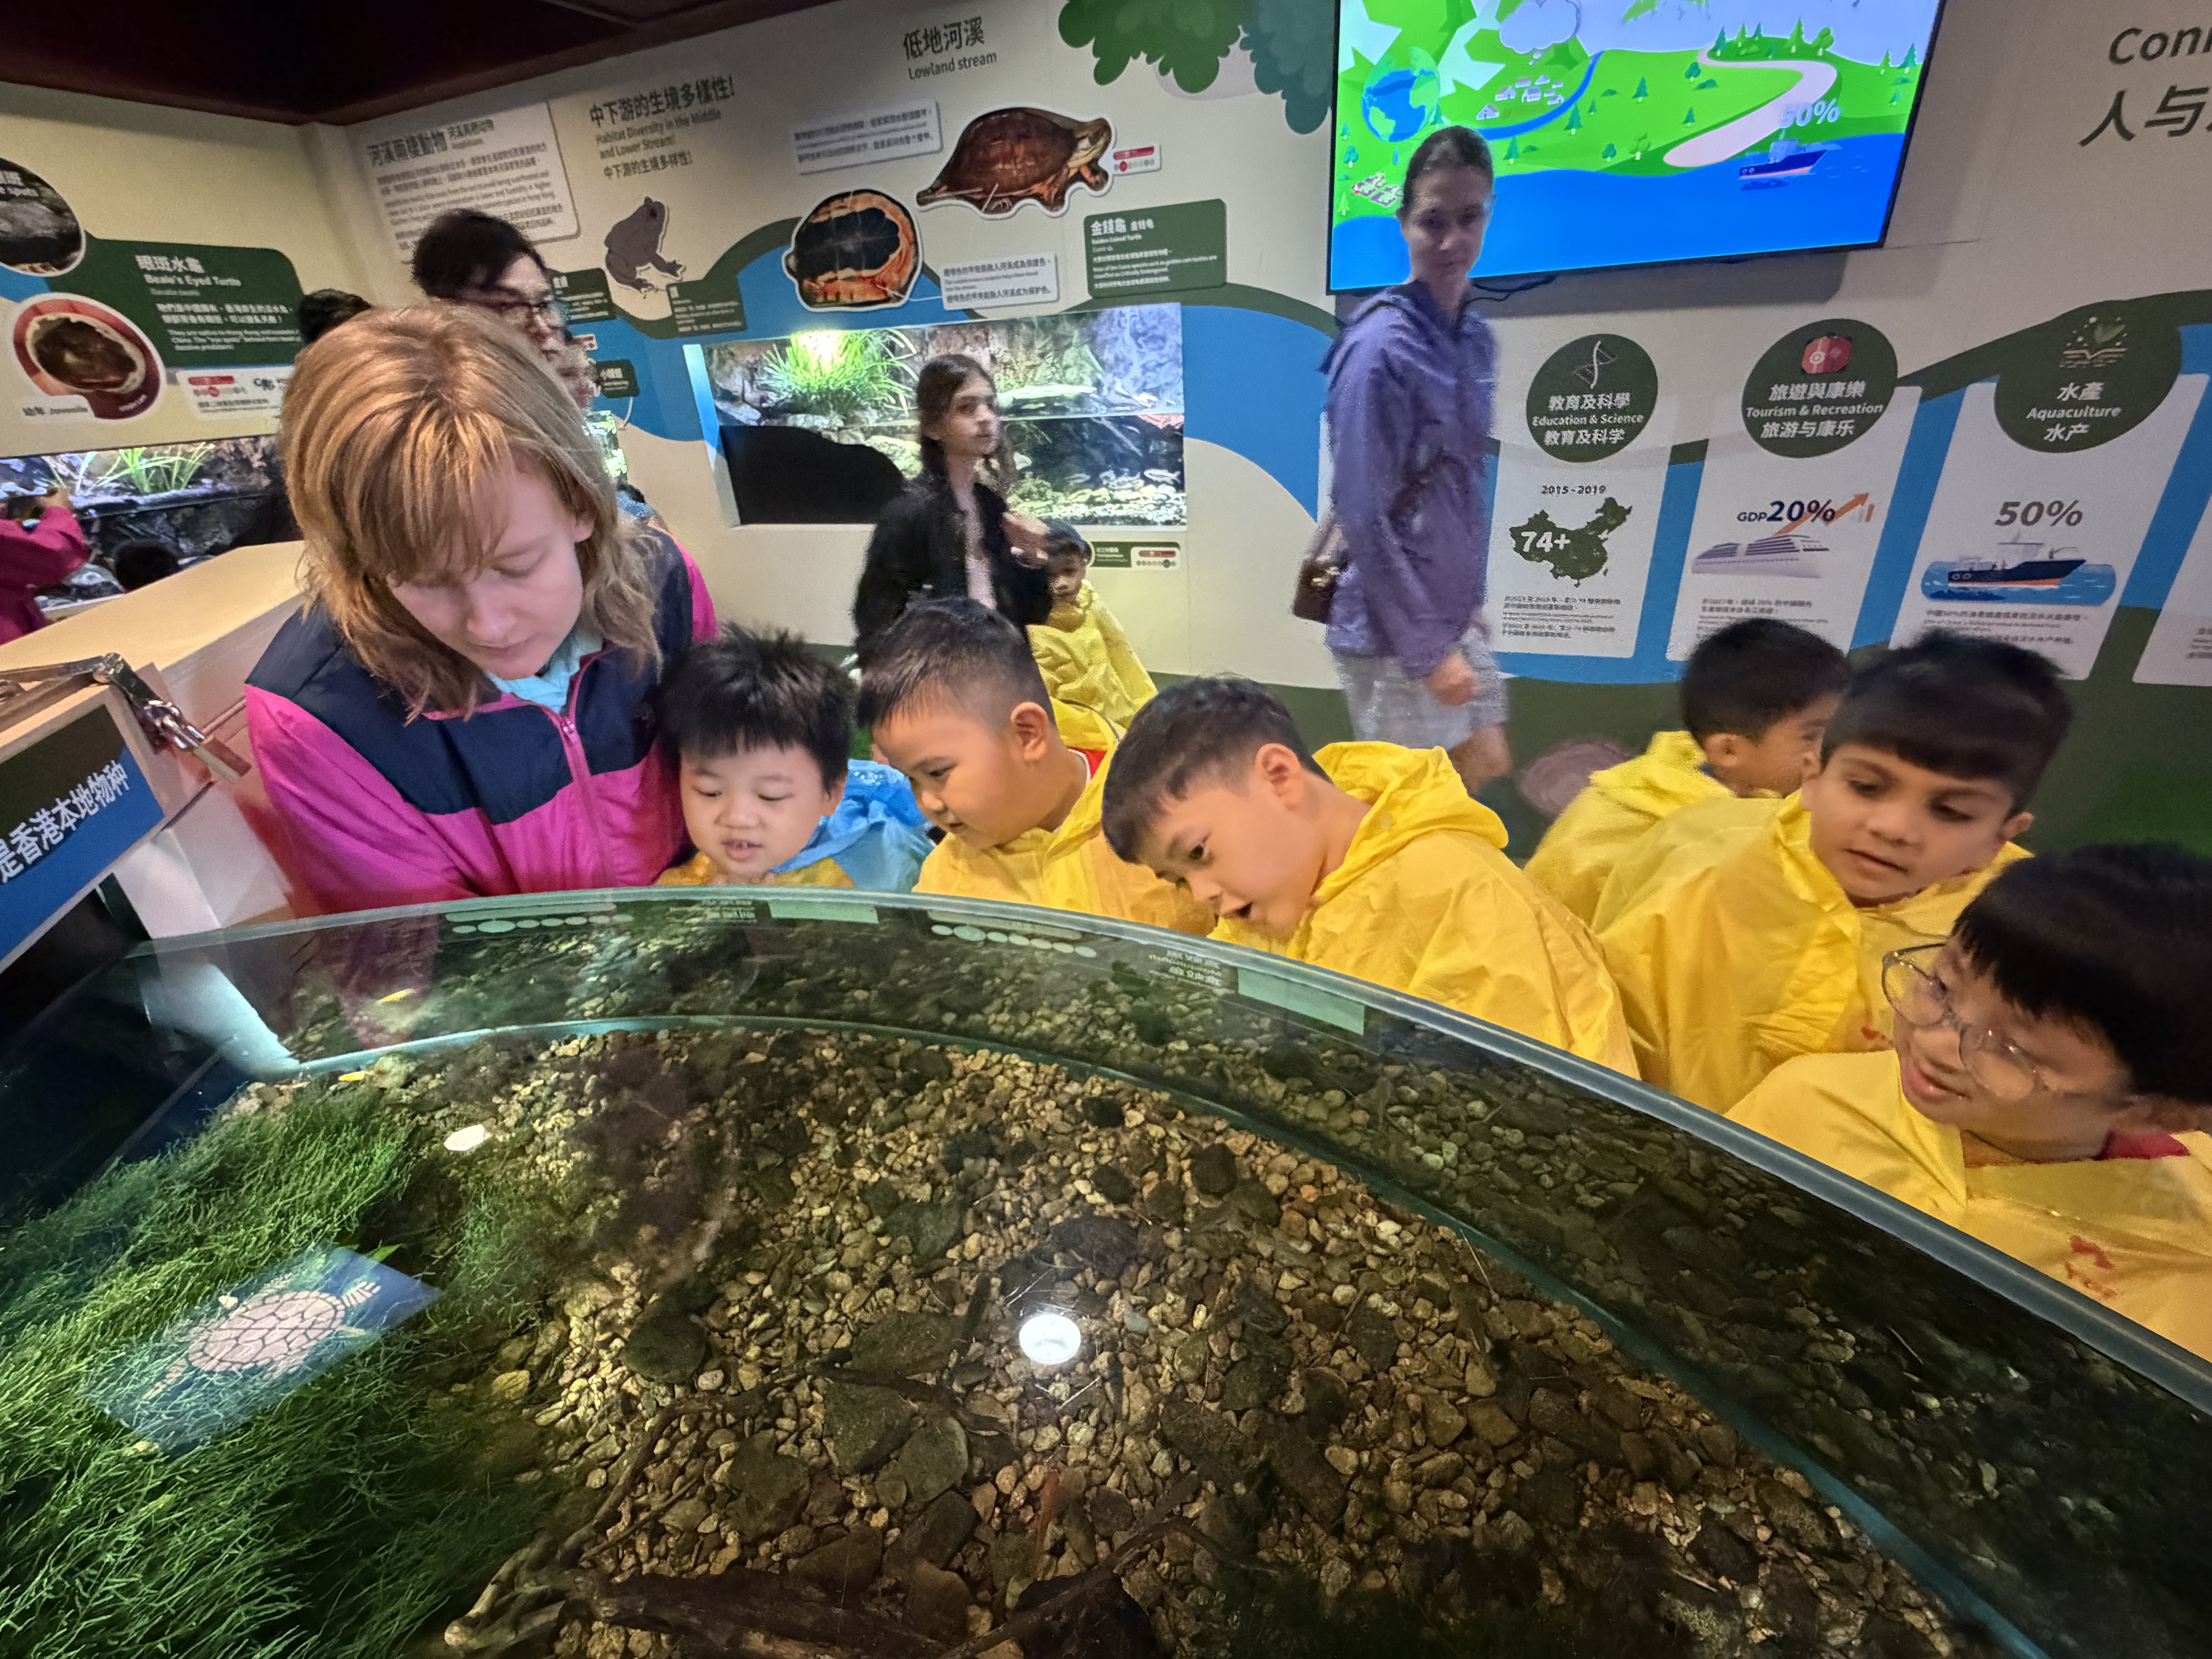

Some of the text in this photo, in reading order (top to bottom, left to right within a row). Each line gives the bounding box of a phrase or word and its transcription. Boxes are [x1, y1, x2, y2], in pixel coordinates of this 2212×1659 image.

[903, 16, 984, 60] 低地河溪
[2109, 26, 2212, 65] Con
[908, 51, 997, 81] Lowland stream
[1779, 98, 1840, 128] 50%
[2078, 84, 2212, 148] 人与
[1769, 380, 1866, 401] 旅遊與康樂
[2056, 381, 2104, 401] 水產
[1548, 392, 1630, 411] 教育及科學
[1747, 402, 1884, 418] Tourism & Recreation
[1532, 413, 1644, 426] Education & Science
[2026, 405, 2122, 422] Aquaculture
[1543, 428, 1625, 446] 教育及科学
[1760, 419, 1855, 439] 旅游与康乐
[2043, 422, 2090, 442] 水产
[1994, 500, 2083, 527] 50%
[1521, 531, 1571, 553] 74+
[0, 759, 130, 884] 是香港本地物种
